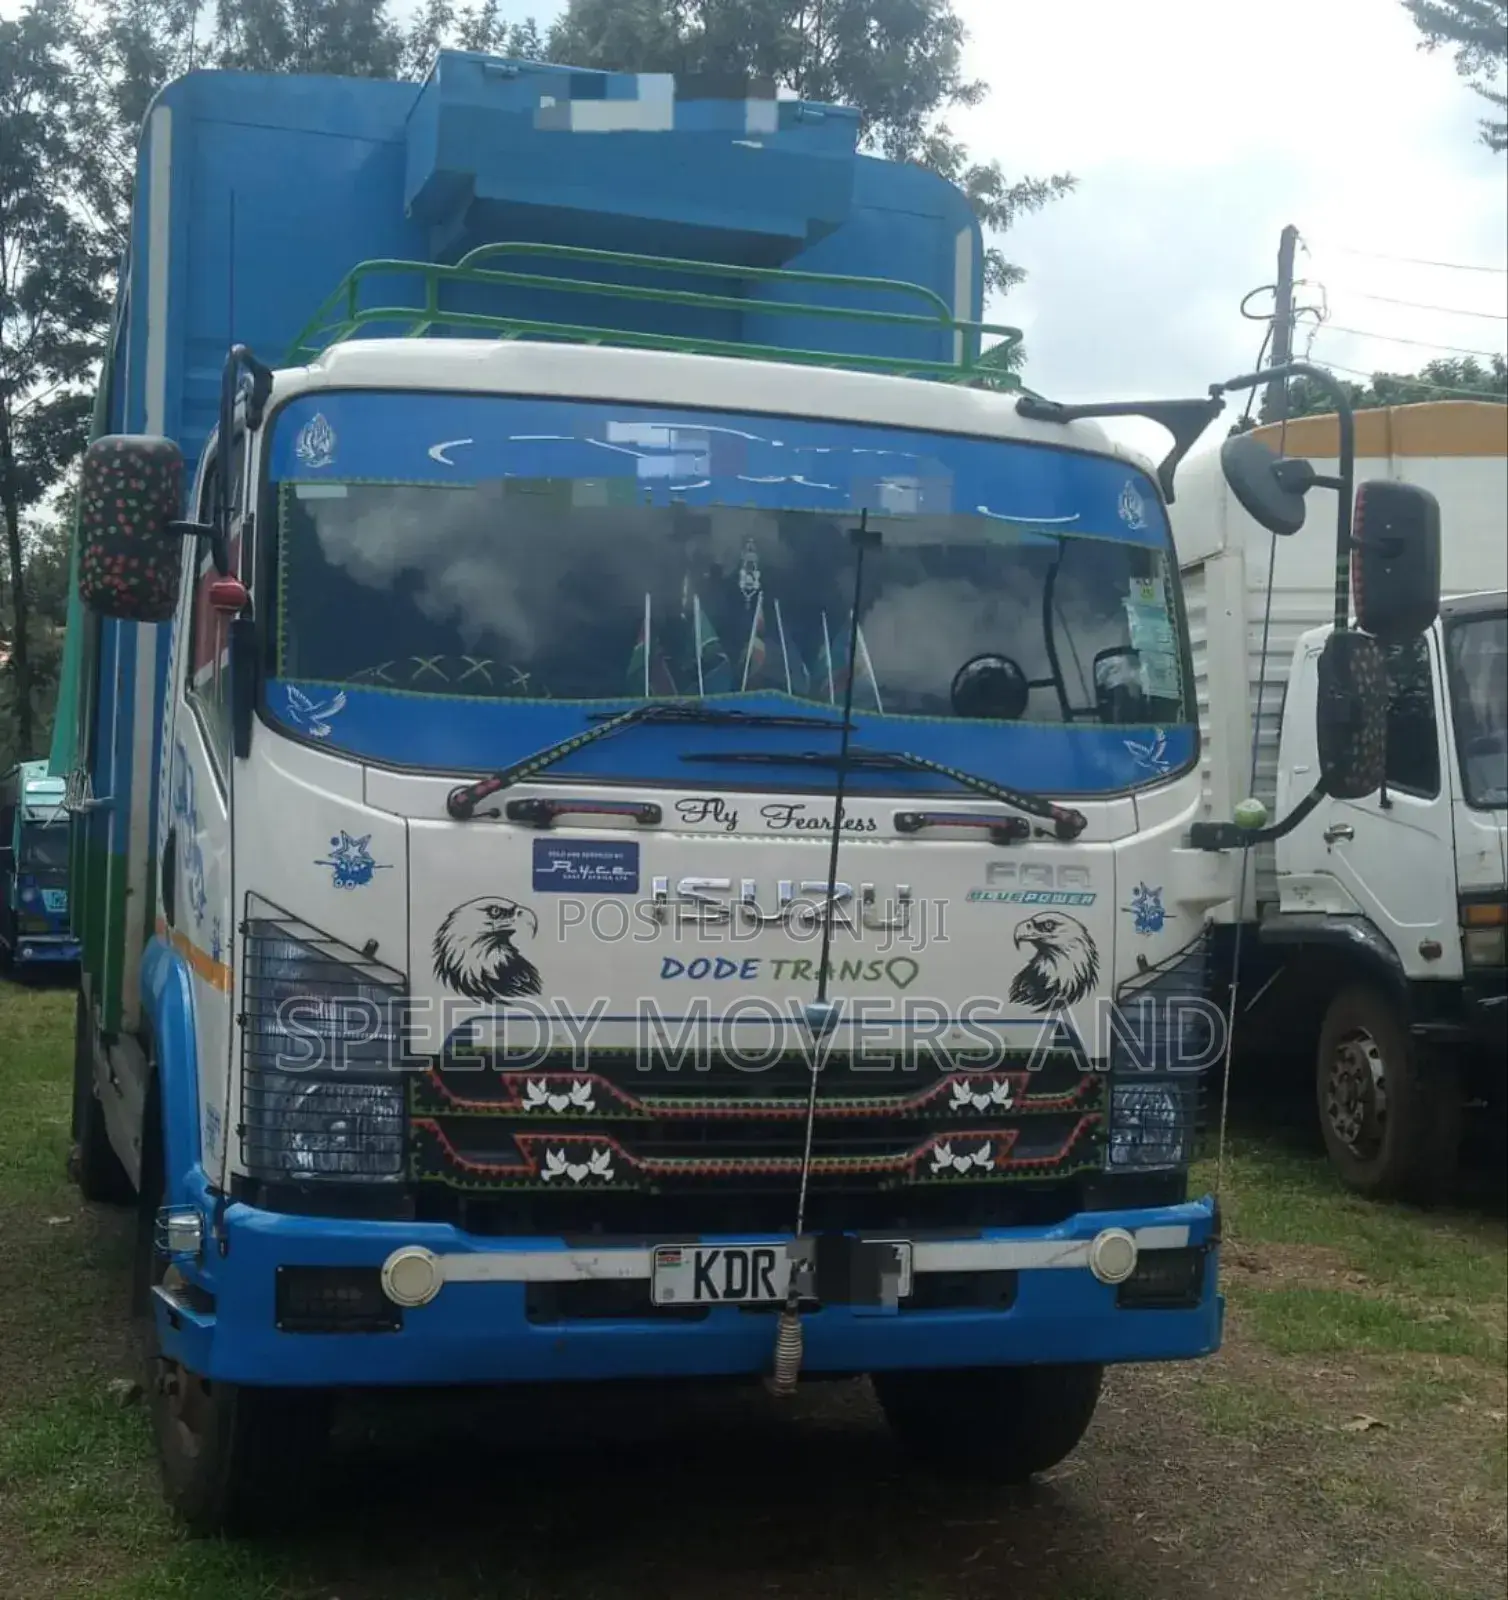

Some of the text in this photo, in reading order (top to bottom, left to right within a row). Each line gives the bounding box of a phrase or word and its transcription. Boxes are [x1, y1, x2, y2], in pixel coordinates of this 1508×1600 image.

[675, 798, 877, 832] Fly Fearless
[651, 876, 912, 931] ISUZU
[660, 957, 763, 981] DODE
[694, 1249, 777, 1300] KDR
